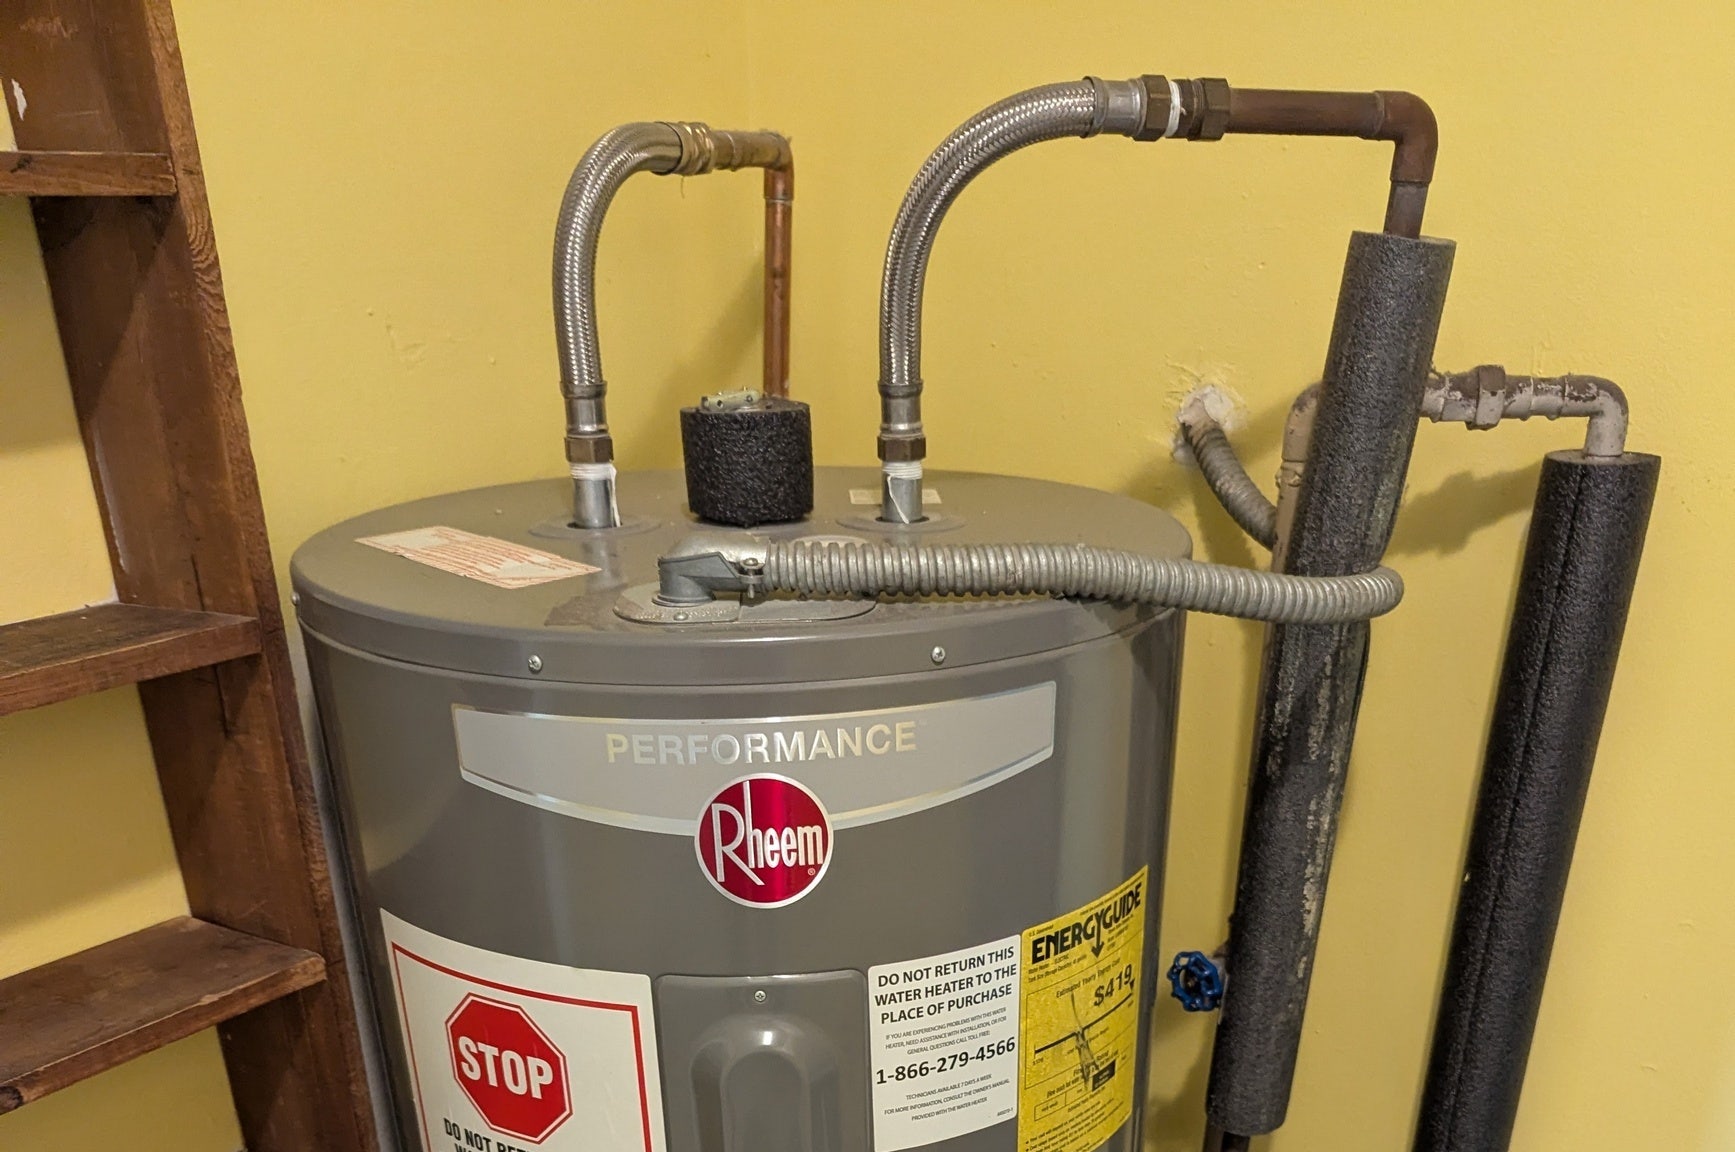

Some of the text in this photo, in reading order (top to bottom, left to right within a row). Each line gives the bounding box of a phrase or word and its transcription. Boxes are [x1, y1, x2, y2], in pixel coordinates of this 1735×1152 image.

[606, 721, 917, 765] PERFORMANCE
[875, 988, 922, 1006] WATER
[925, 976, 974, 998] HEATER
[976, 972, 992, 986] TO
[994, 963, 1017, 980] THE
[878, 973, 900, 988] DO
[903, 967, 932, 983] NOT
[935, 954, 985, 977] RETURN
[987, 946, 1014, 964] THIS
[1093, 963, 1133, 1007] $419
[881, 983, 1012, 1024] PLACE OF PURCHASE
[457, 1035, 553, 1100] STOP
[876, 1036, 1016, 1084] 1-866-279-4566
[443, 1117, 461, 1141] DO
